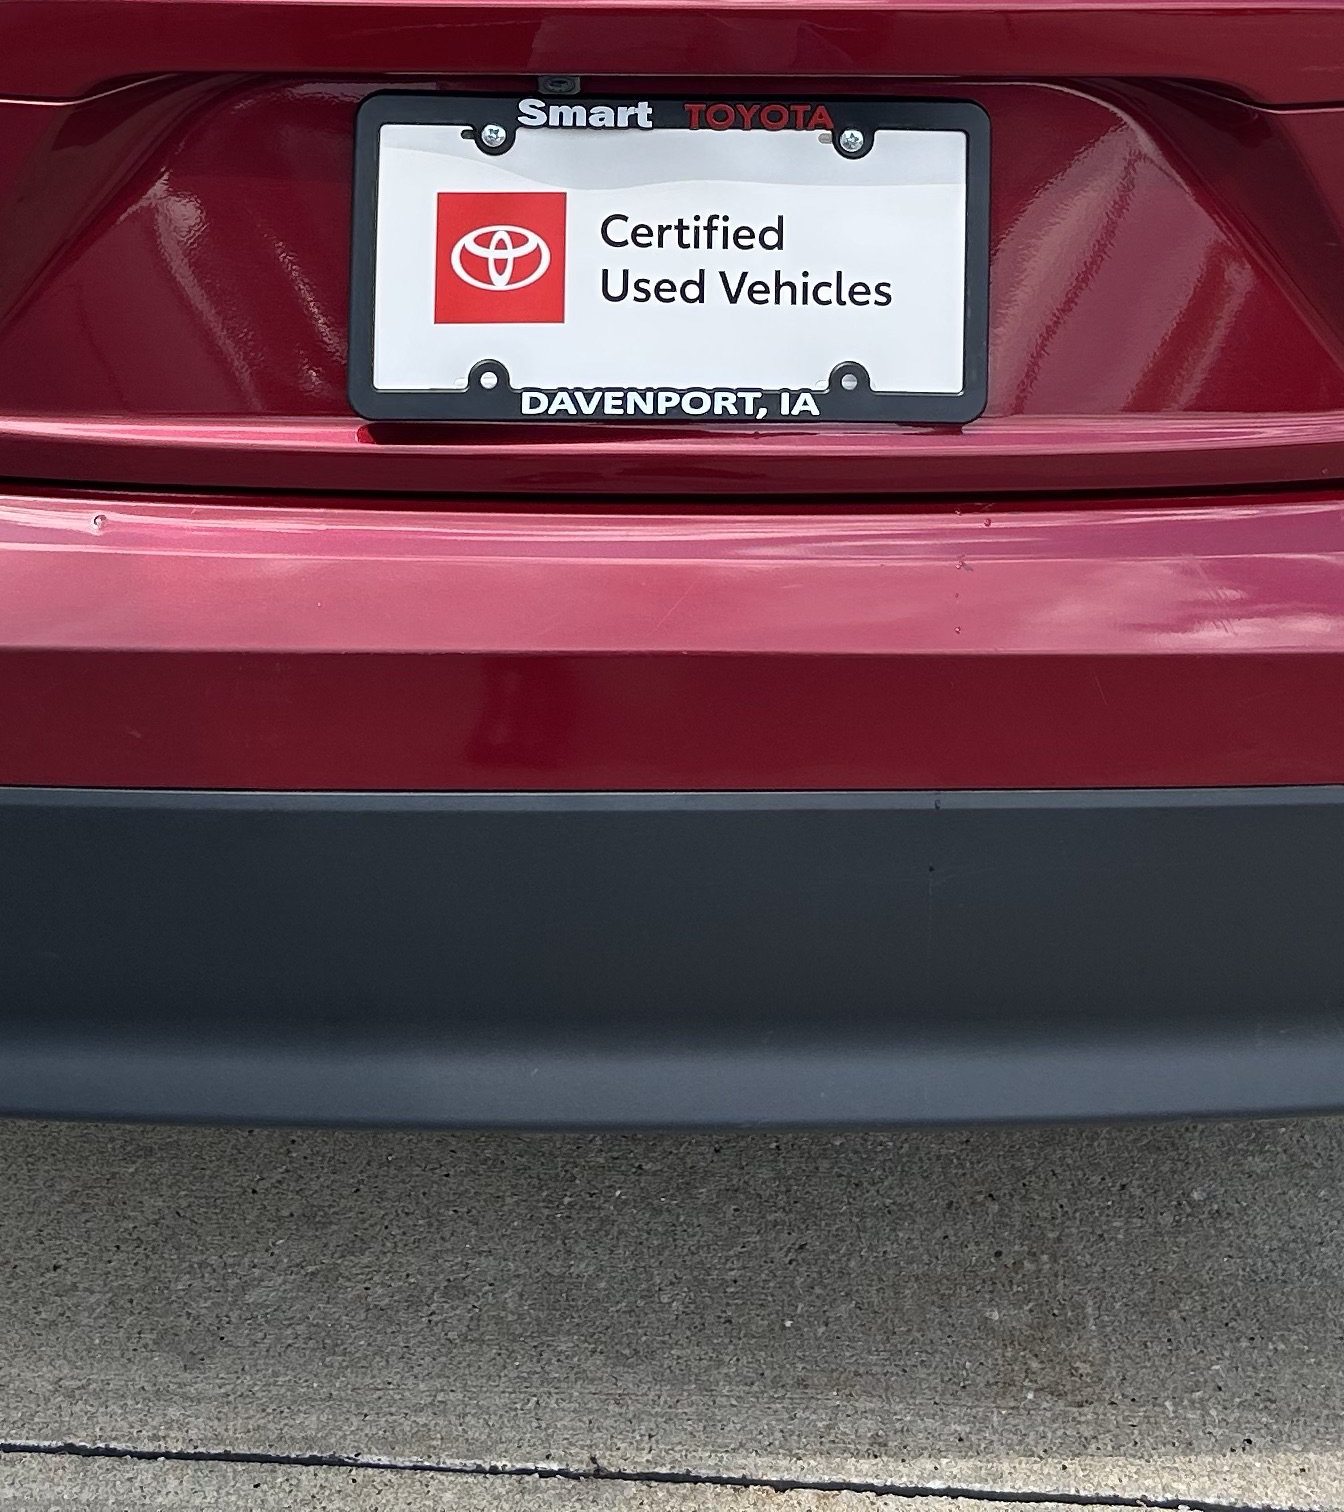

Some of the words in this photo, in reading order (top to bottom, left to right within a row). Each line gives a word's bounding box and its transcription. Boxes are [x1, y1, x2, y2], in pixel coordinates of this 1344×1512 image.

[517, 98, 654, 128] Smart
[683, 103, 835, 130] TOYOTA
[600, 213, 784, 251] Certified
[601, 268, 706, 304] Used
[718, 269, 893, 307] Vehicles
[520, 390, 768, 420] DAVENPORT,
[779, 391, 821, 416] IA
